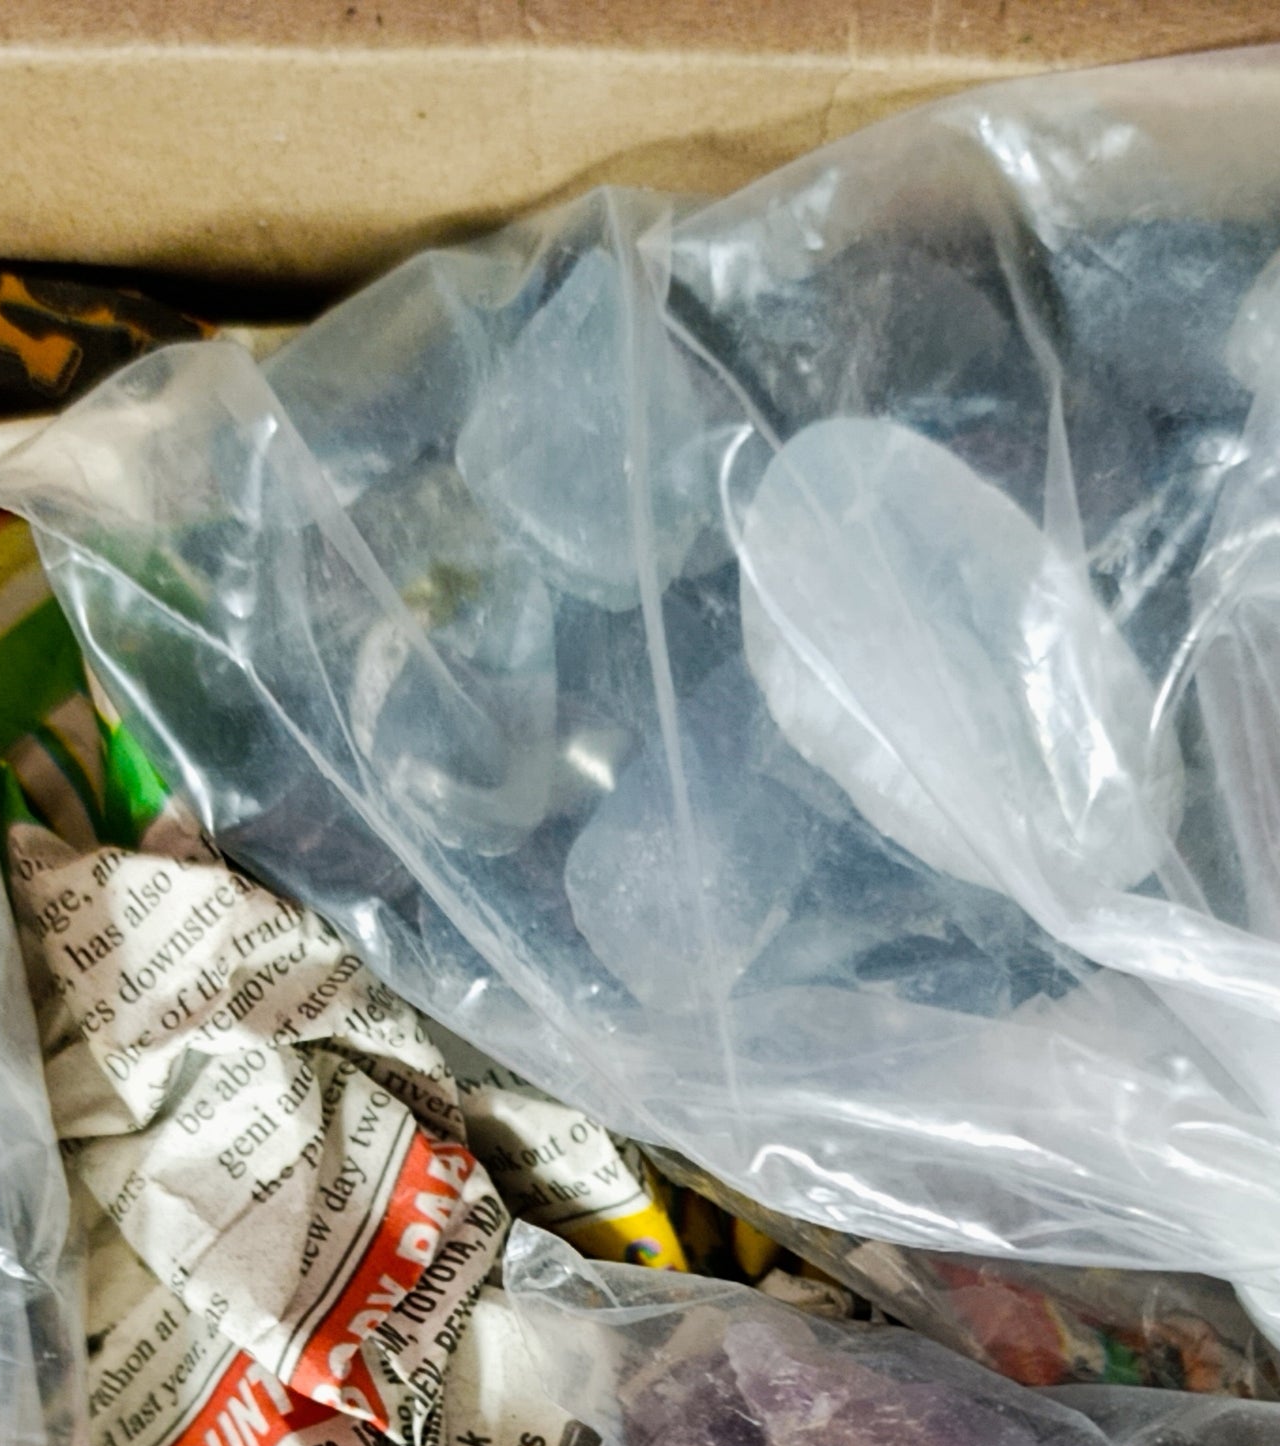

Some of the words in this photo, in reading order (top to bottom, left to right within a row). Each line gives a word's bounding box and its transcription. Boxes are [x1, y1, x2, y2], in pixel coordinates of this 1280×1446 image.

[63, 922, 125, 974] has
[123, 869, 173, 930] also
[118, 870, 261, 1005] downstrea
[160, 986, 196, 1032] of
[196, 953, 230, 1003] the
[175, 1097, 217, 1138] be
[297, 952, 366, 1021] aroun
[250, 1163, 295, 1205] the
[319, 1156, 368, 1213] day
[348, 1091, 393, 1148] two
[547, 1178, 593, 1203] the
[392, 1239, 488, 1325] TOYOTA,
[117, 1390, 163, 1441] last
